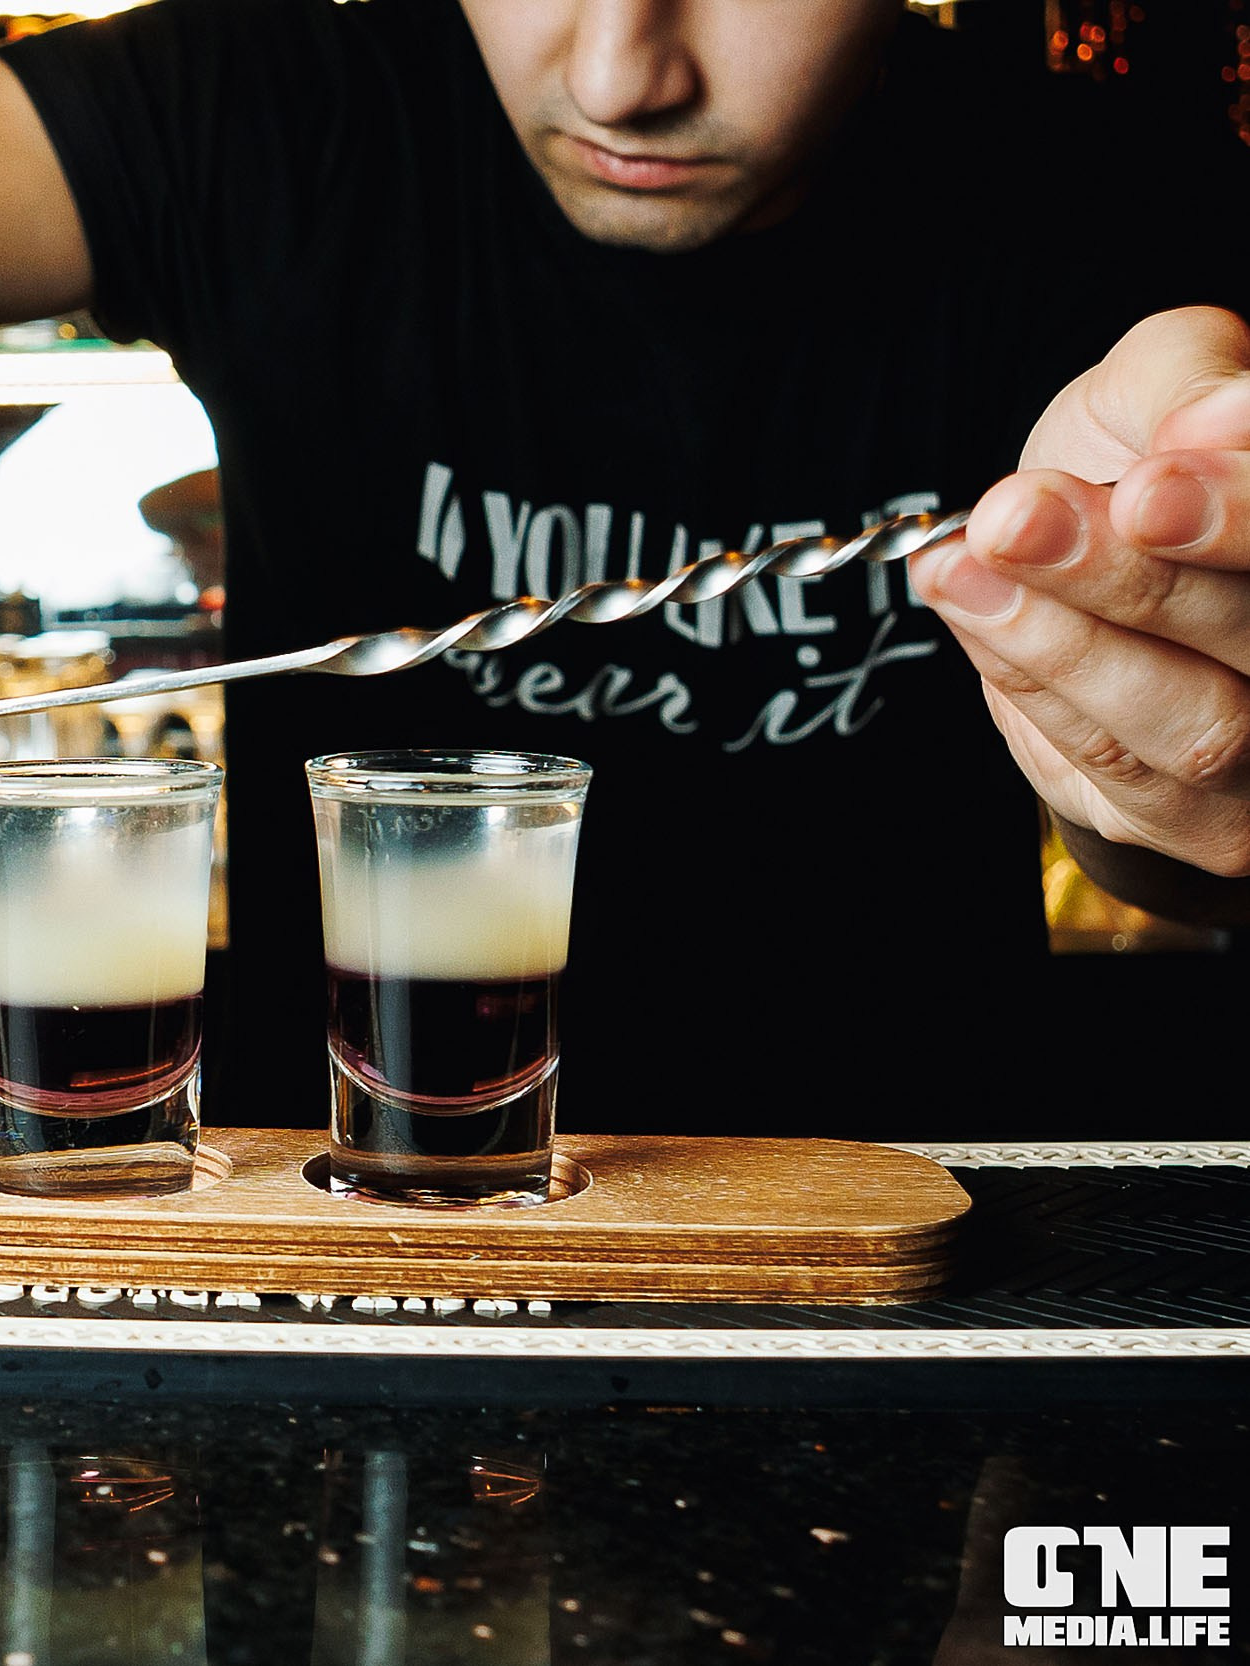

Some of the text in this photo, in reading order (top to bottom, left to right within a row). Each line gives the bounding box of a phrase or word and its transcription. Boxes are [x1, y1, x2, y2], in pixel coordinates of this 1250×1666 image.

[482, 490, 645, 600] YOU
[664, 520, 839, 648] LIKE
[722, 611, 940, 752] it
